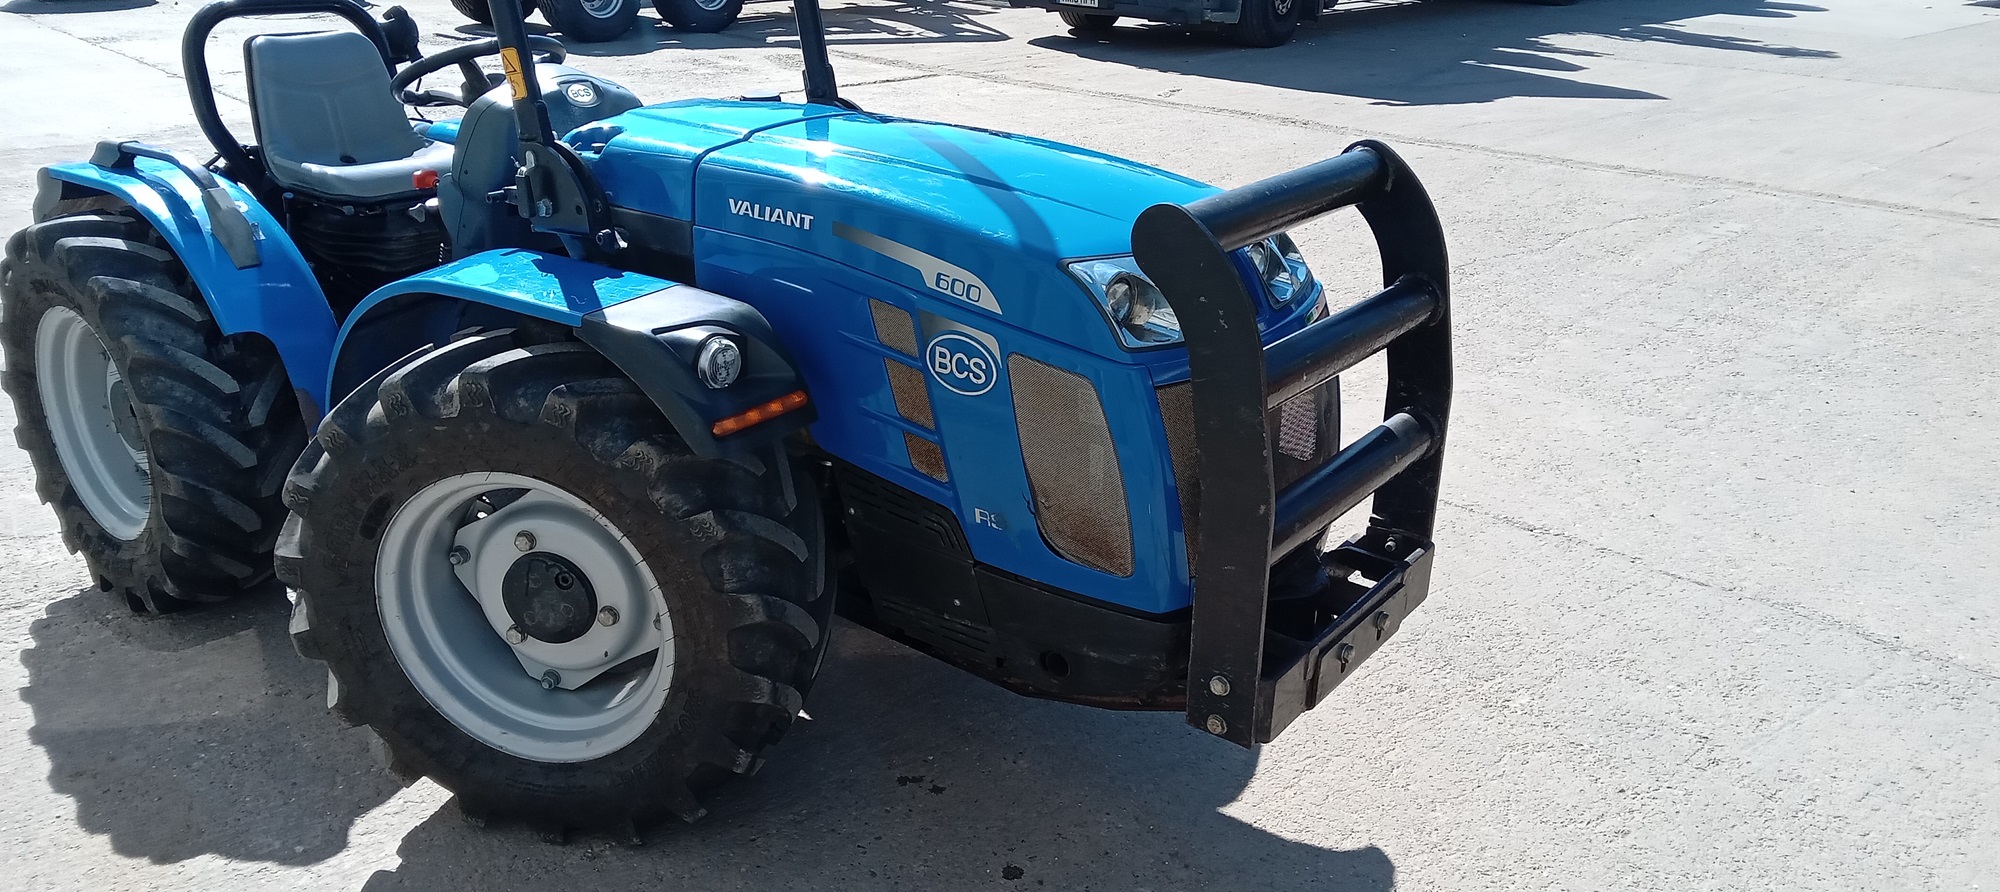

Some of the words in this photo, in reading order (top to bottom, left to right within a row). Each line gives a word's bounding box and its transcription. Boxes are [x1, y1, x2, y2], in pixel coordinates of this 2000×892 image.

[571, 88, 591, 98] BCS
[729, 198, 814, 230] VALIANT
[935, 272, 981, 303] 600
[935, 346, 987, 385] BCS
